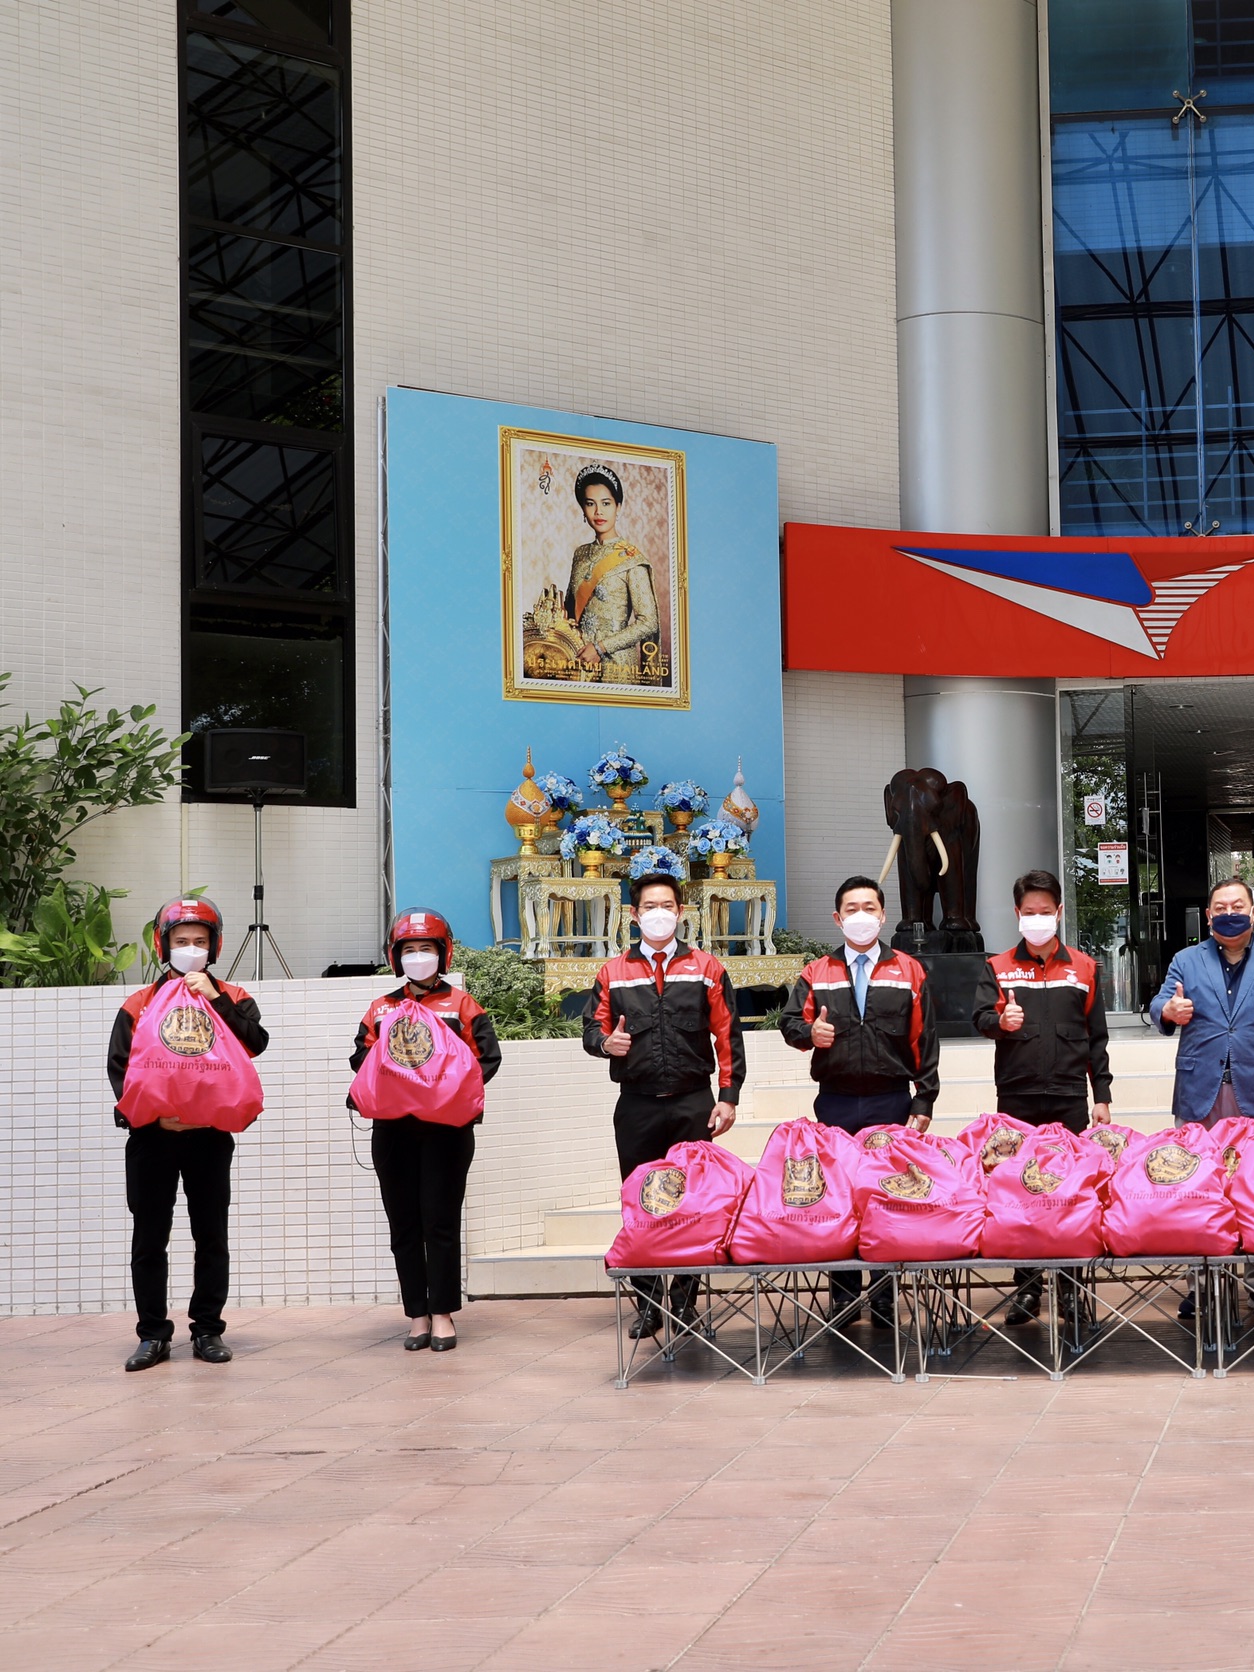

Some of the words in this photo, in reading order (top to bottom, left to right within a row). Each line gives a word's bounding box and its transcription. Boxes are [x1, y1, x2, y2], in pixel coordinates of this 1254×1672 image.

[527, 656, 602, 672] ประเทศไทย
[605, 662, 669, 677] THAILAND
